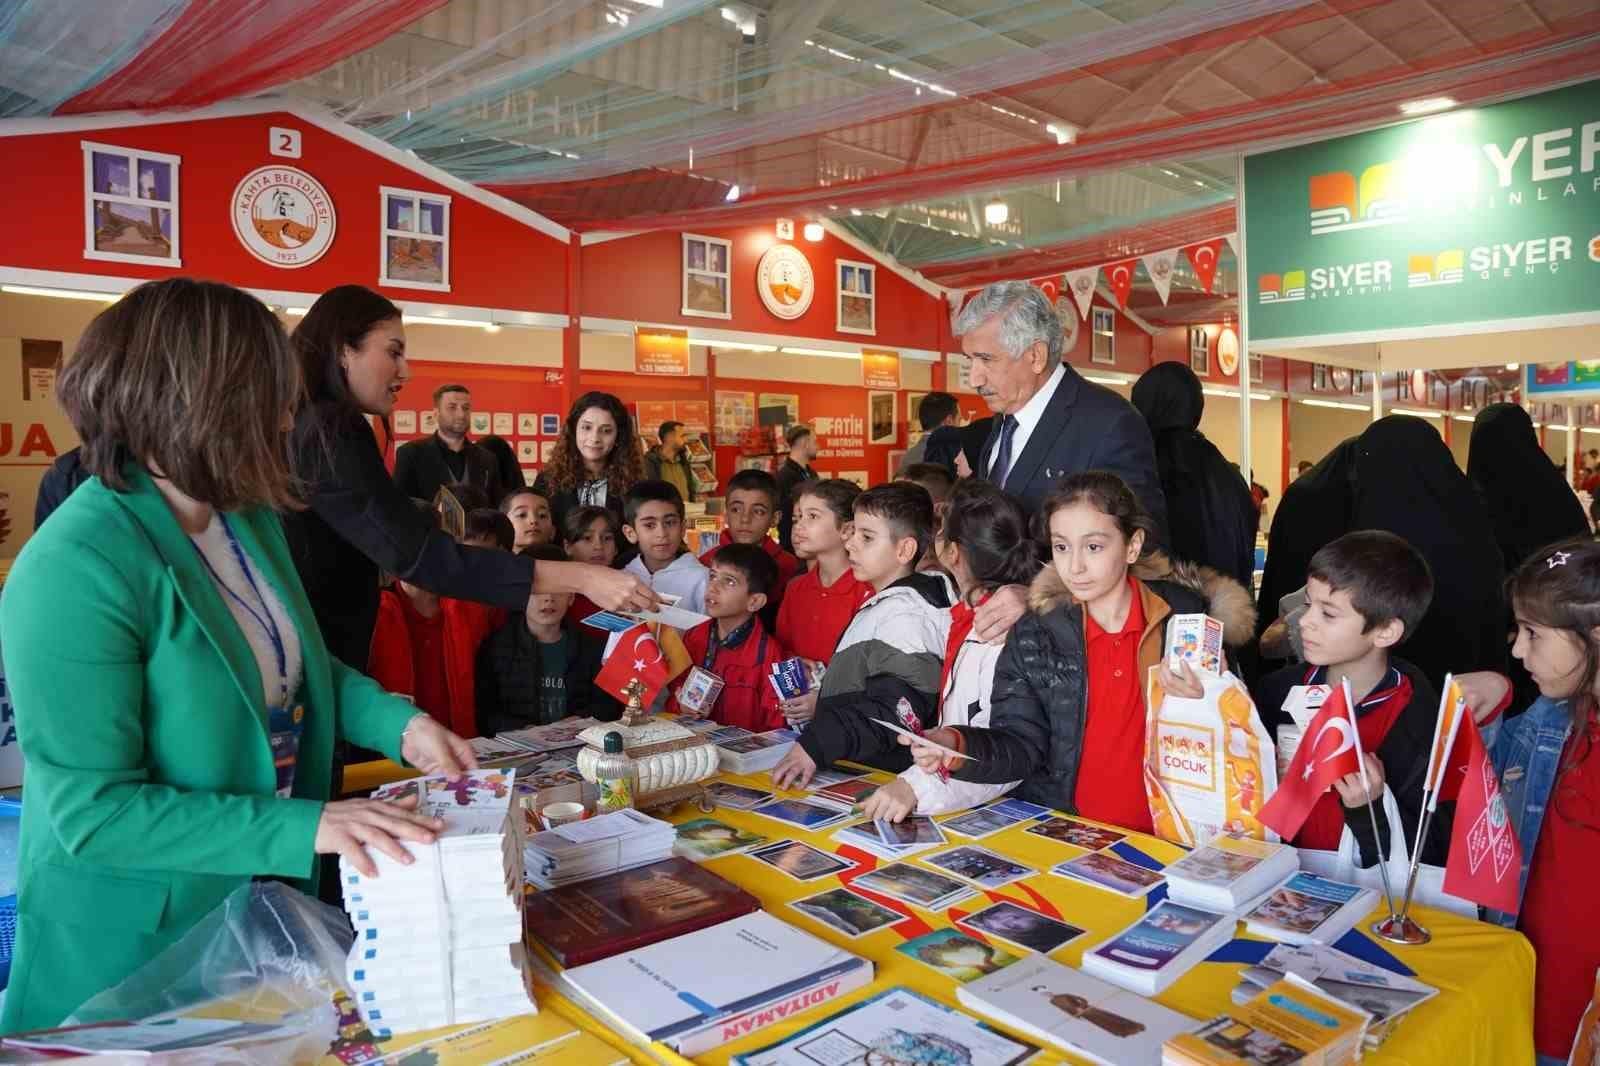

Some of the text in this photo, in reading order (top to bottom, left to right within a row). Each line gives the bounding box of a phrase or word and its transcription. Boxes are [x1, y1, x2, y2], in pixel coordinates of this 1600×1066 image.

[279, 134, 293, 152] 2
[239, 175, 271, 210] KAHTA
[1163, 755, 1208, 775] ÇOCUK
[723, 982, 840, 1041] ADIYAMAN
